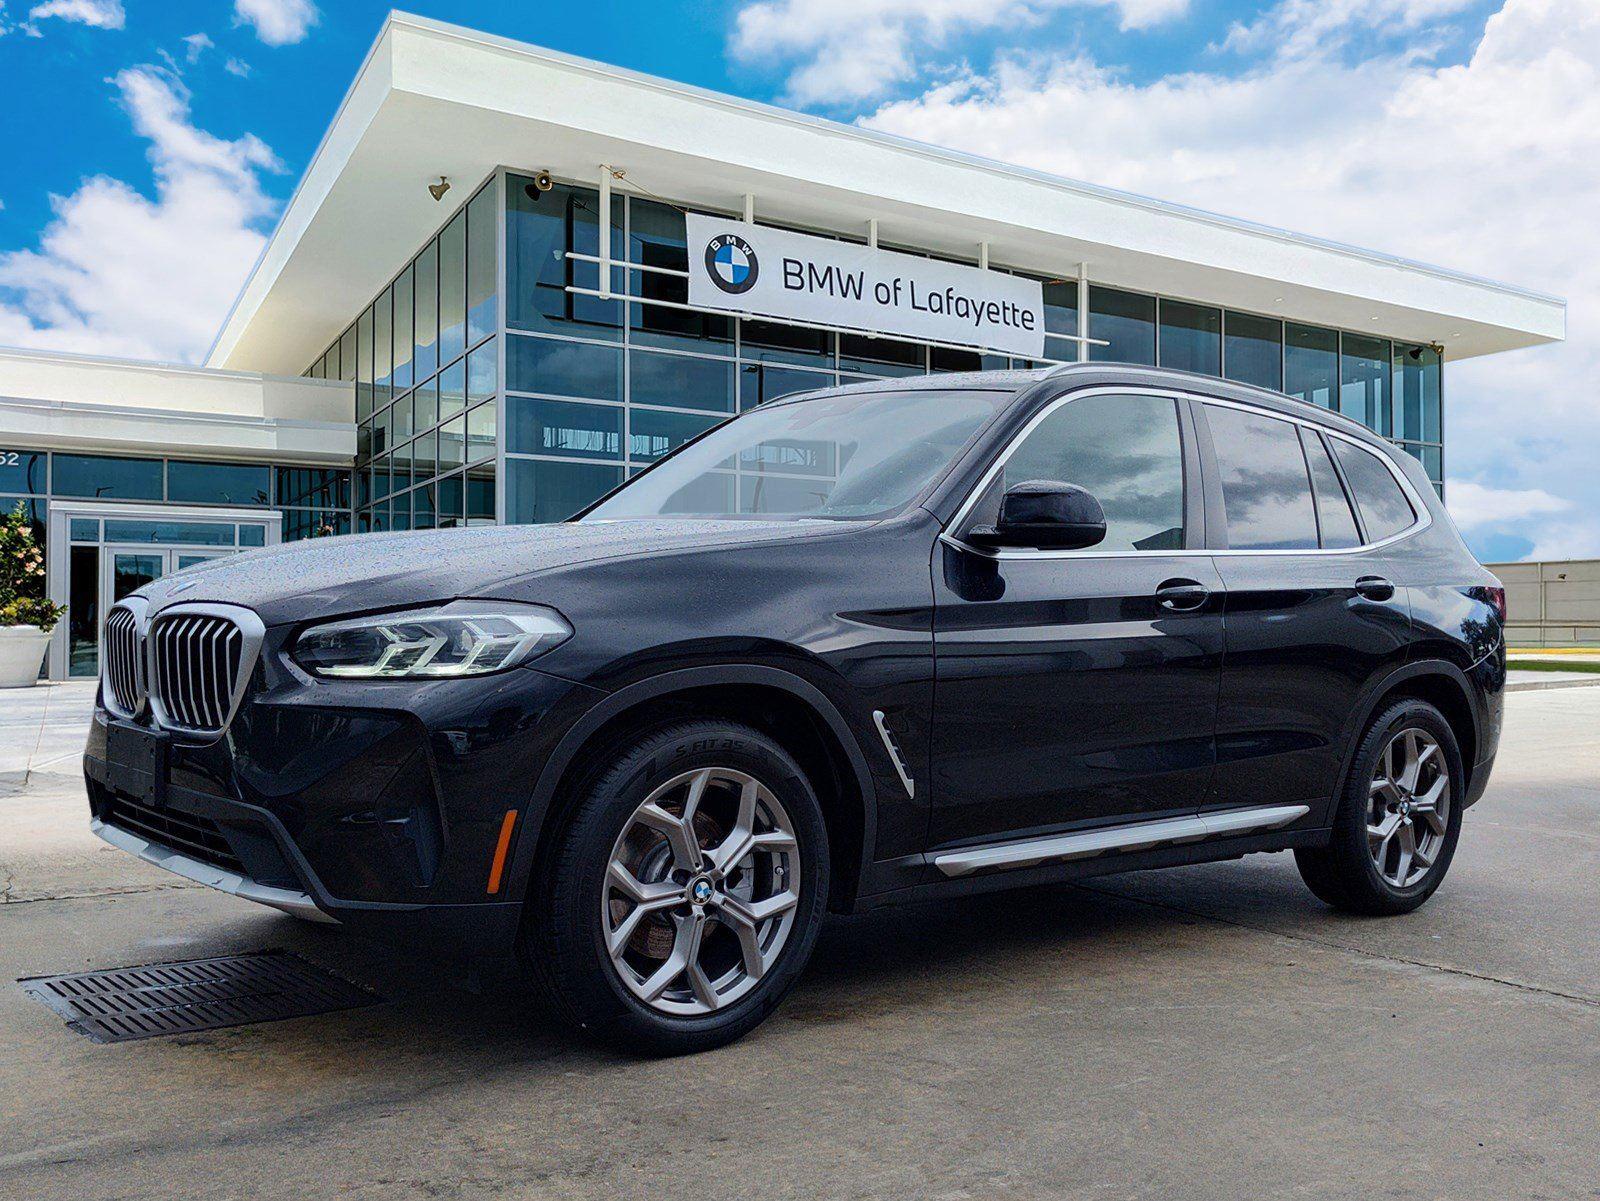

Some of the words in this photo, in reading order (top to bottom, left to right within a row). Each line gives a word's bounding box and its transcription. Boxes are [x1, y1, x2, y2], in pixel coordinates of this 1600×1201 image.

[710, 235, 752, 255] BMW
[783, 258, 864, 301] BMW
[875, 277, 902, 306] of
[911, 281, 1035, 330] Lafayette
